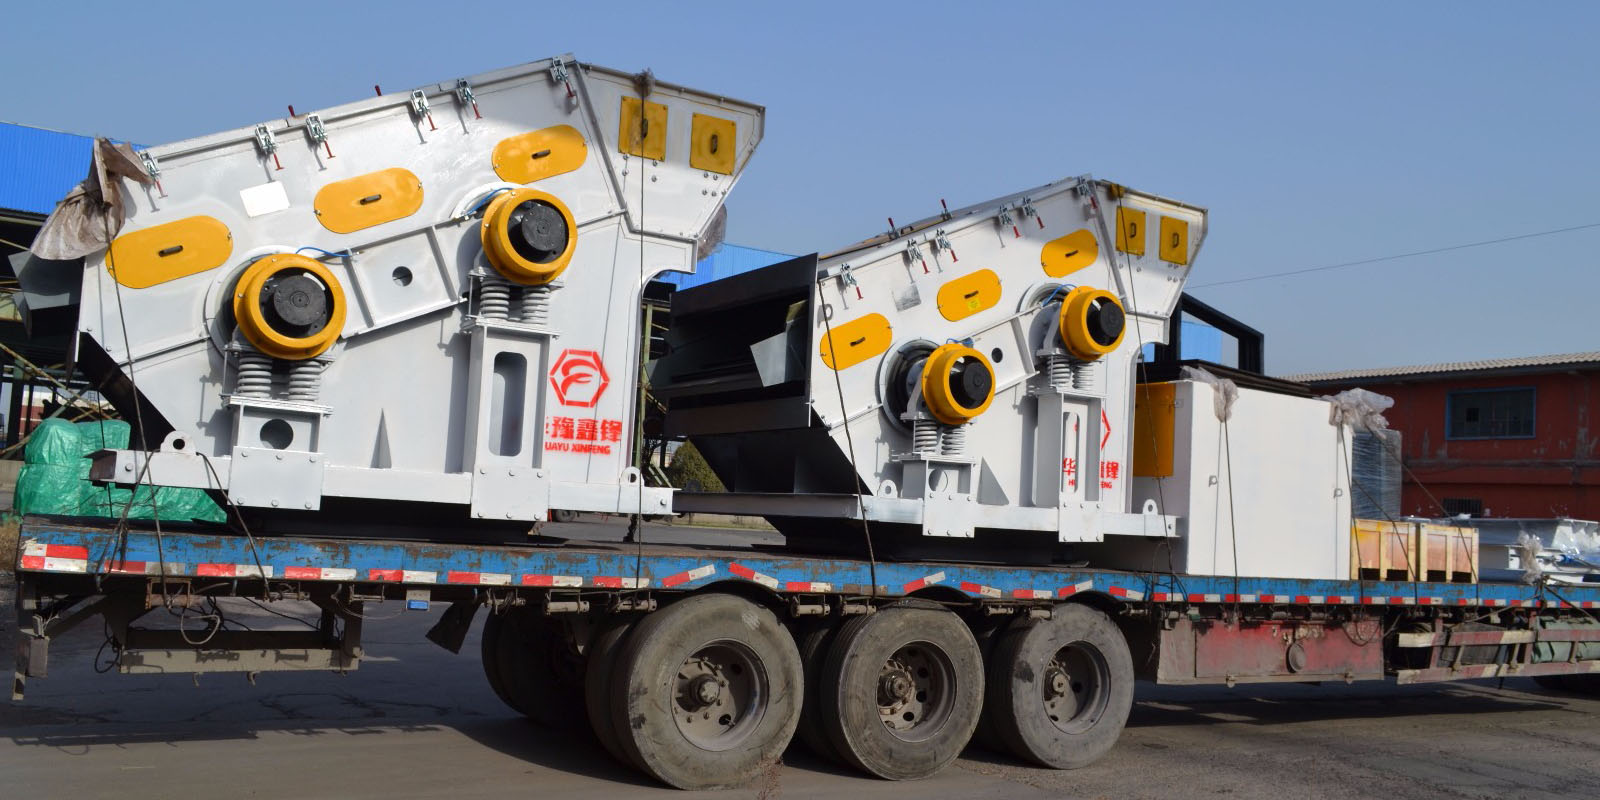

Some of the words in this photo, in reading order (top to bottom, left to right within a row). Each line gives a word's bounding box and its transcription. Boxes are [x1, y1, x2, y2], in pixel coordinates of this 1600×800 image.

[545, 416, 623, 442] 豫鑫锋
[571, 444, 611, 455] XINFENG
